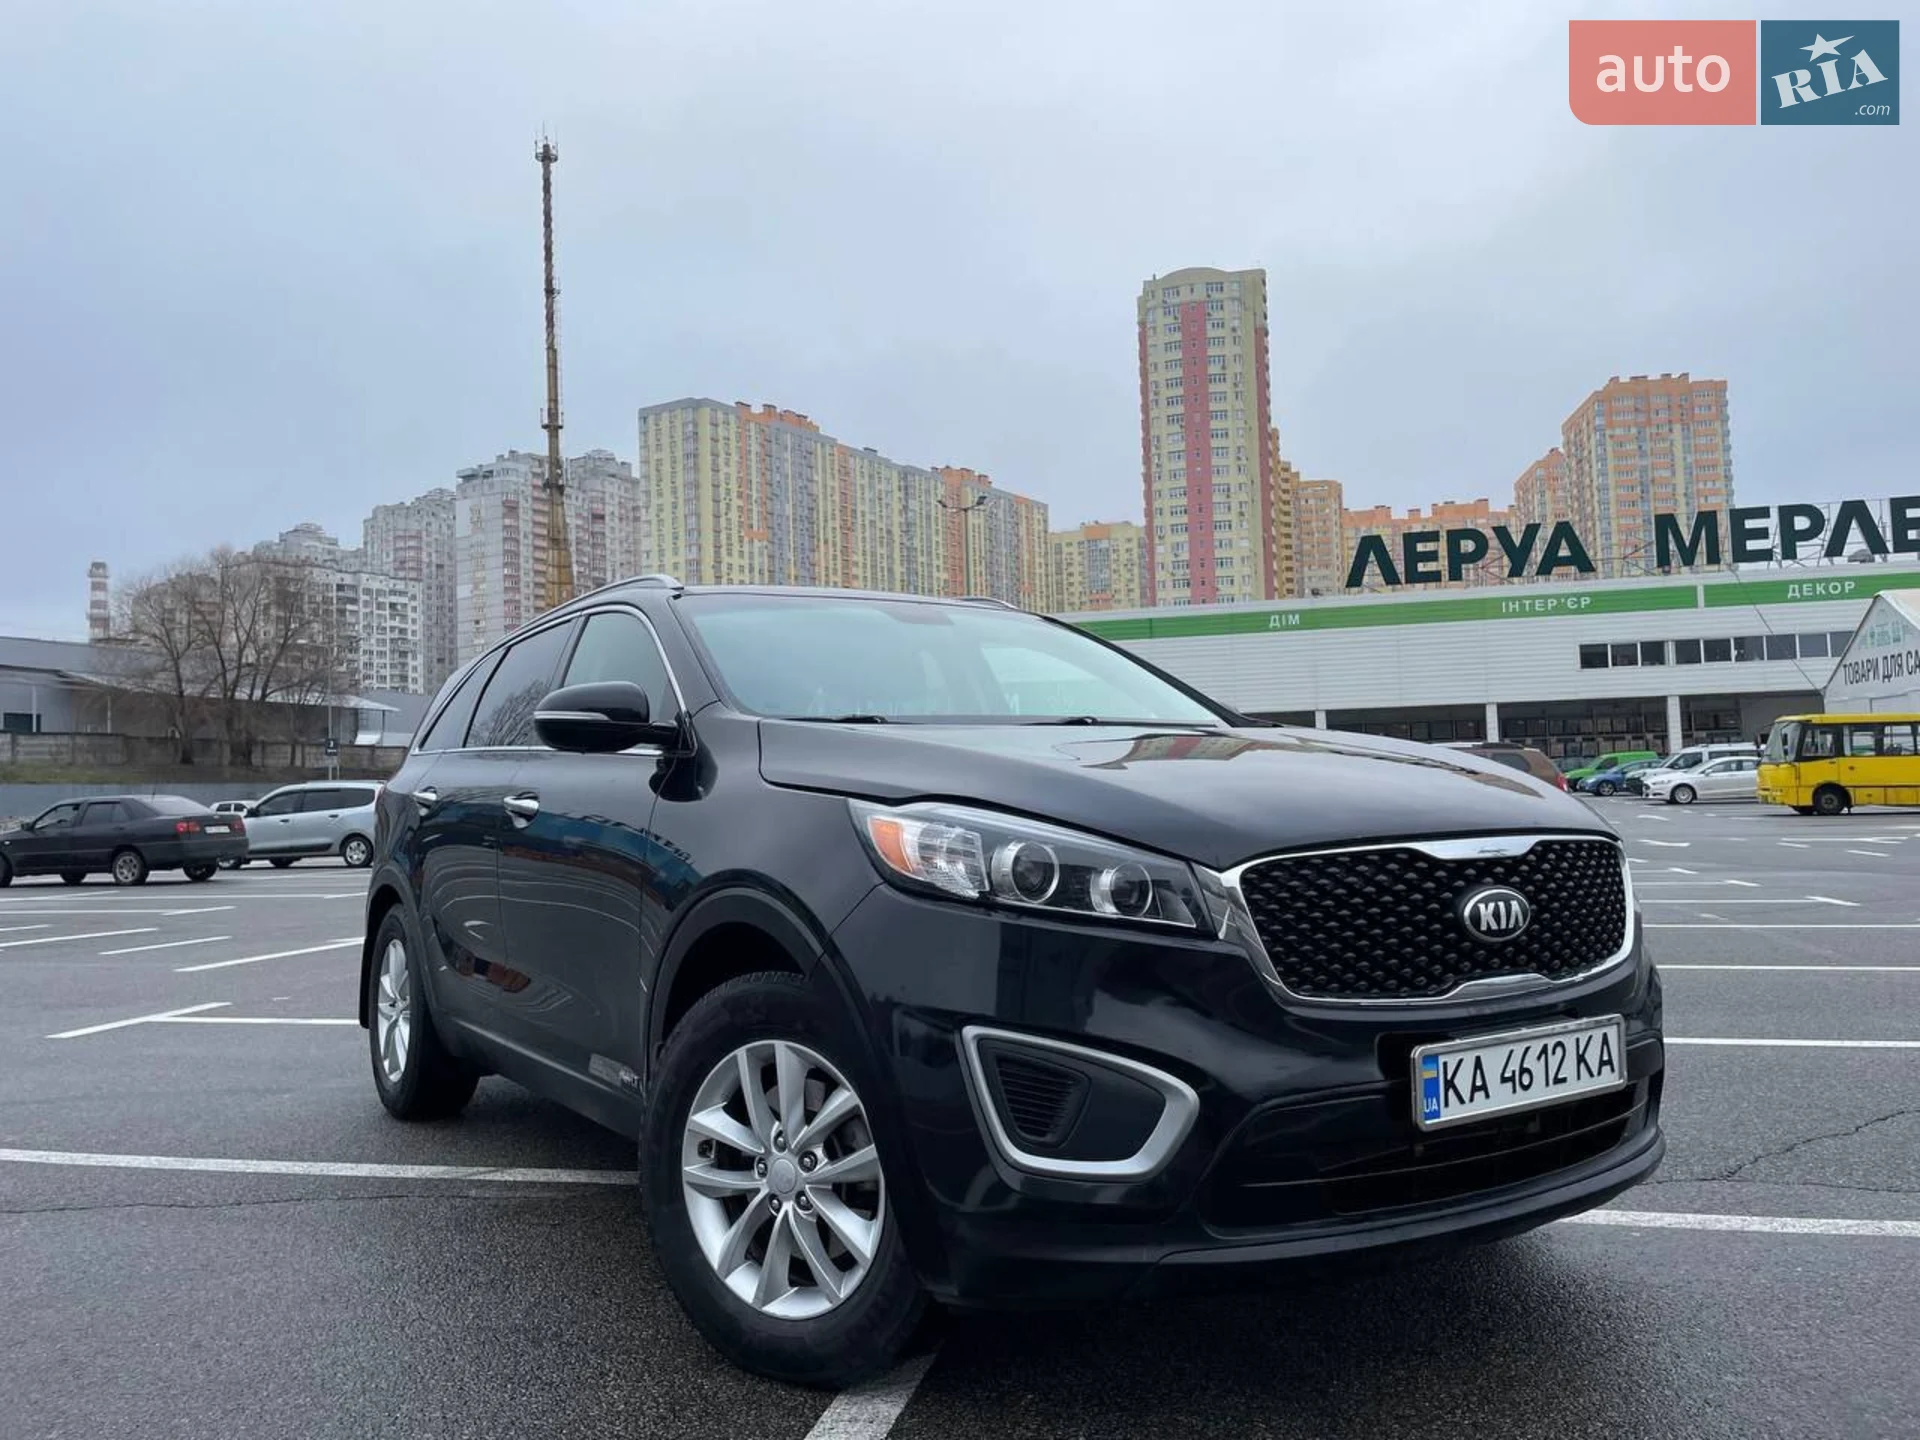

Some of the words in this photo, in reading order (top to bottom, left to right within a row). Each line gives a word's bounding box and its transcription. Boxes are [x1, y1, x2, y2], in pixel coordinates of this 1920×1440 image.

[1345, 520, 1596, 588] ЛЕРУА
[1787, 581, 1856, 599] ДЕКОР
[1269, 613, 1300, 629] ДІМ
[1843, 656, 1880, 685] ТОВАРИ
[1882, 653, 1905, 684] ДЛЯ
[1478, 900, 1524, 931] KIA
[1442, 1055, 1490, 1108] KA
[1499, 1040, 1568, 1094] 4612
[1575, 1031, 1616, 1081] KA
[1423, 1098, 1438, 1113] UA
